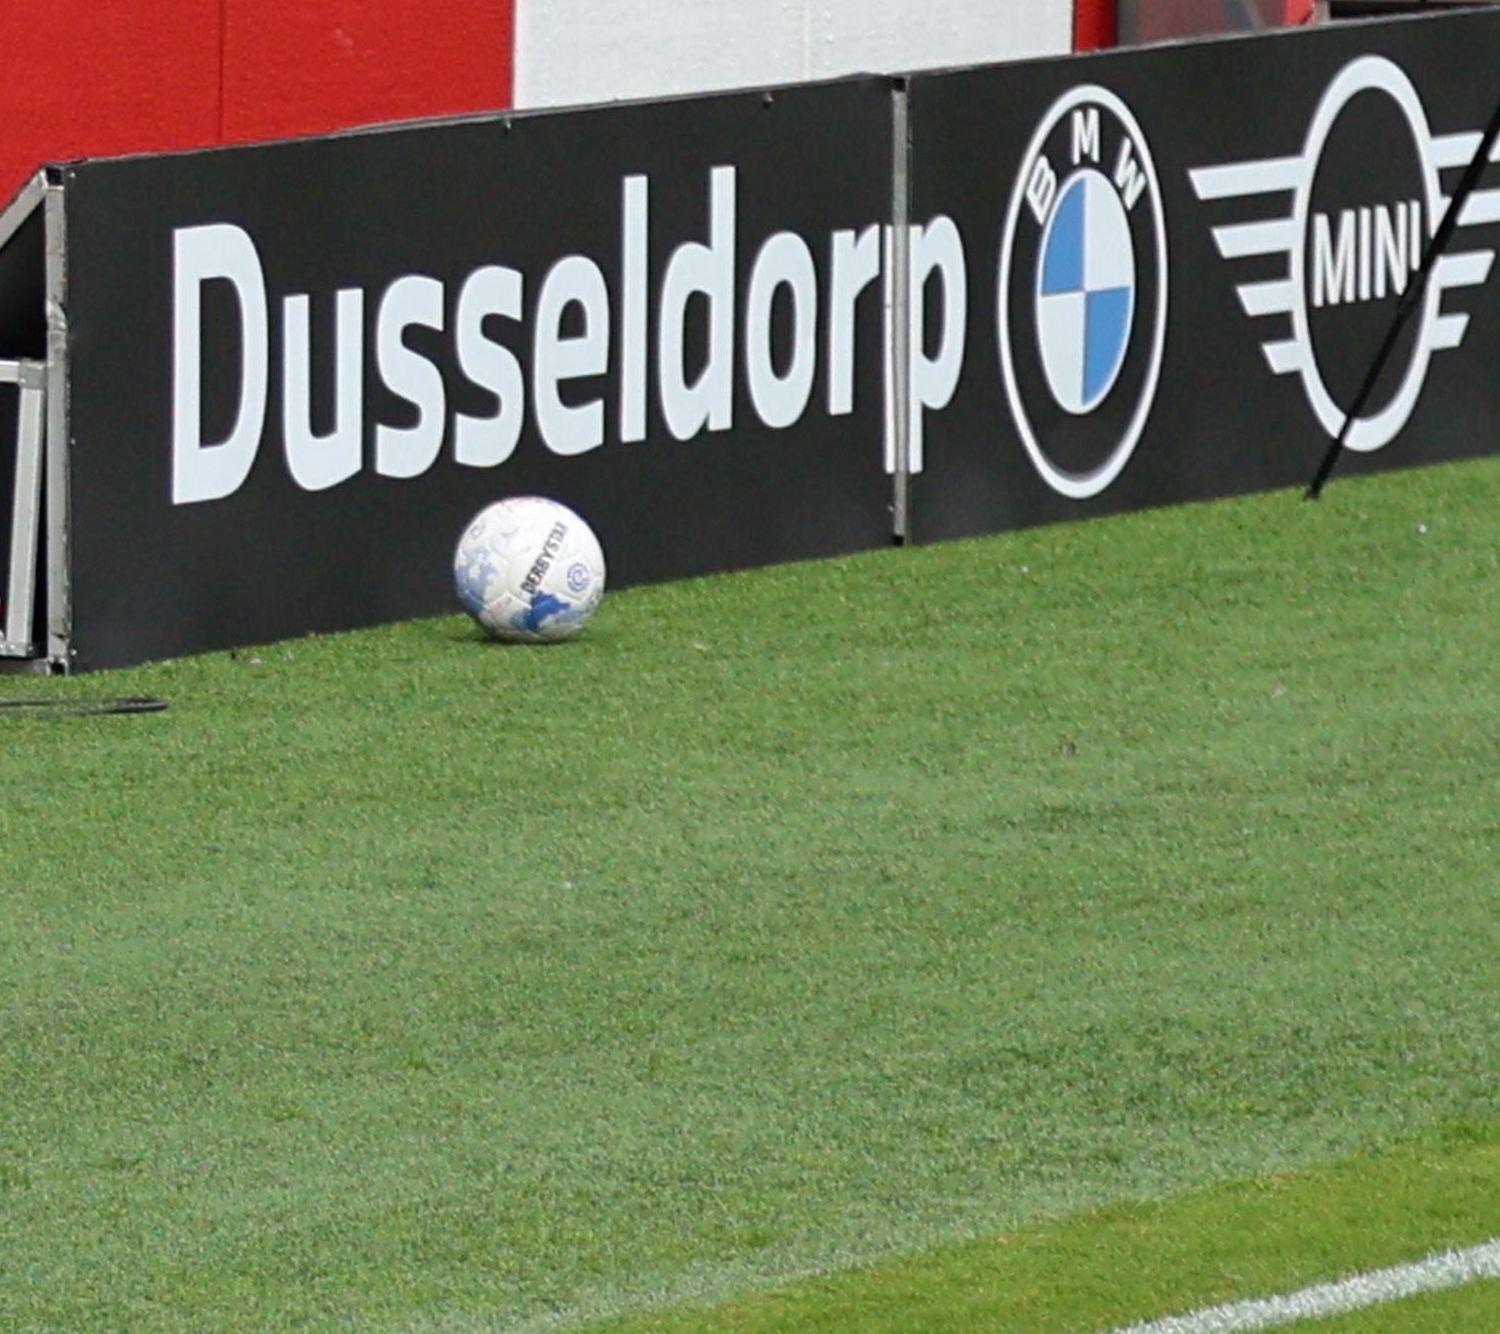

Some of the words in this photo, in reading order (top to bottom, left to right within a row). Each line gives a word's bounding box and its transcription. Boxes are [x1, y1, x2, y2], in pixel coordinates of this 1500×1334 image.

[1026, 108, 1147, 226] BMW
[1313, 200, 1421, 307] MINI
[171, 164, 967, 506] Dusseldorp
